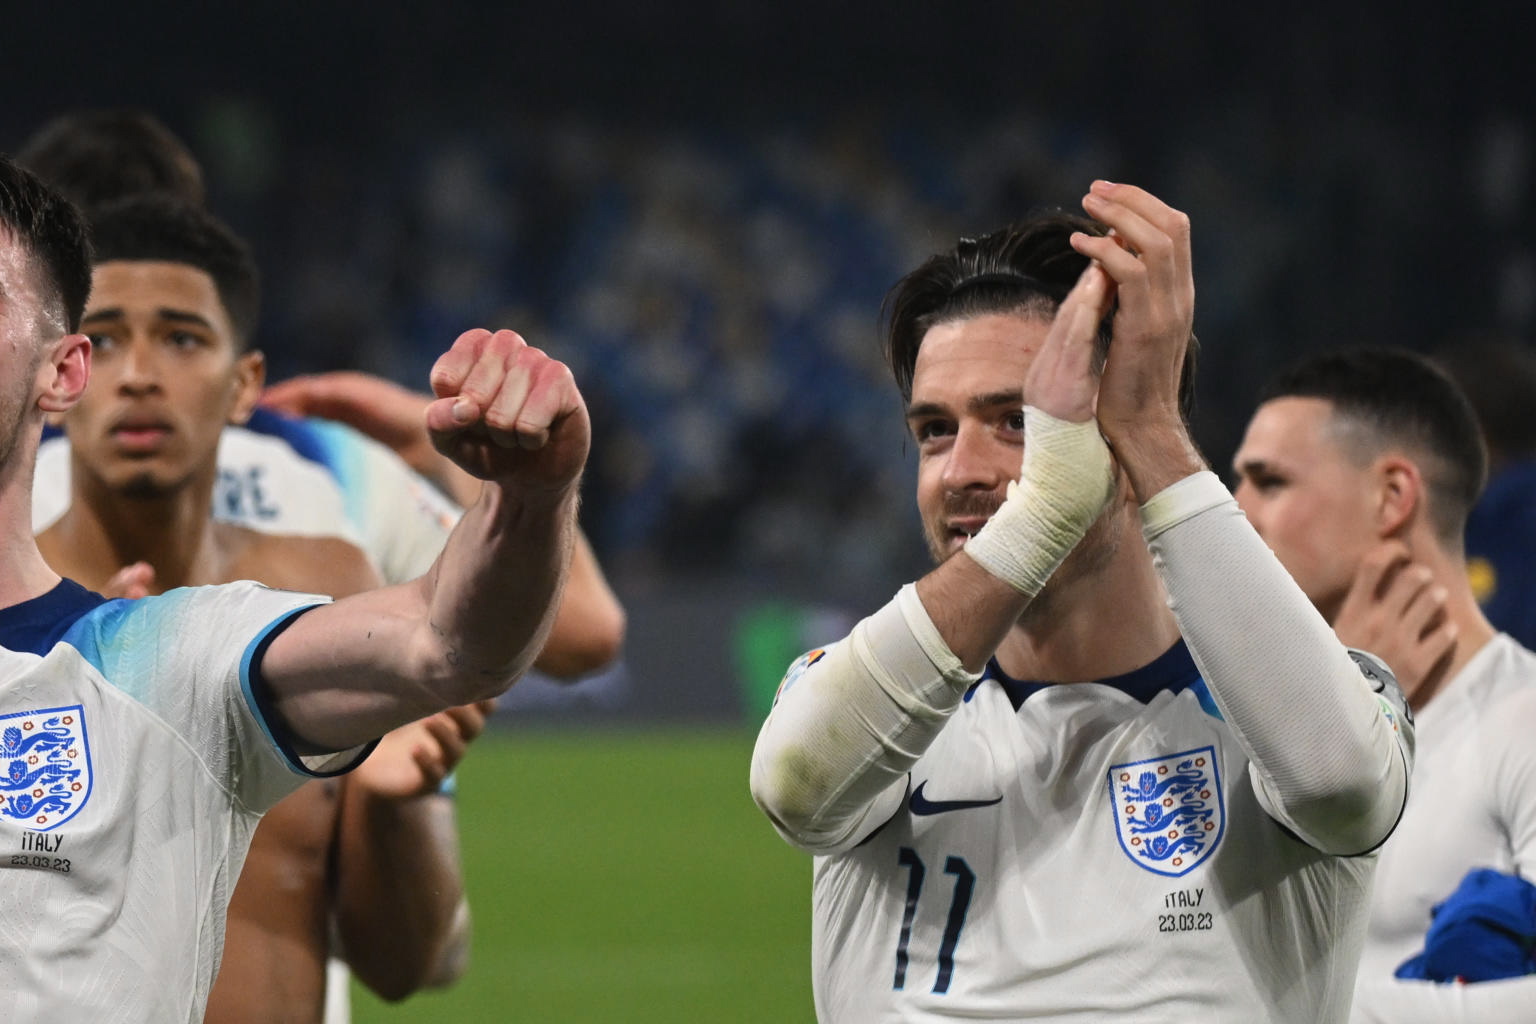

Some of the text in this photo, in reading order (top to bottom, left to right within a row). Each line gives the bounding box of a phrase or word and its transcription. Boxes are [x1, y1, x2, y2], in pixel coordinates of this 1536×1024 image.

[10, 855, 72, 873] 23.03.23
[892, 846, 978, 996] 11
[1158, 911, 1213, 933] 23.03.23
